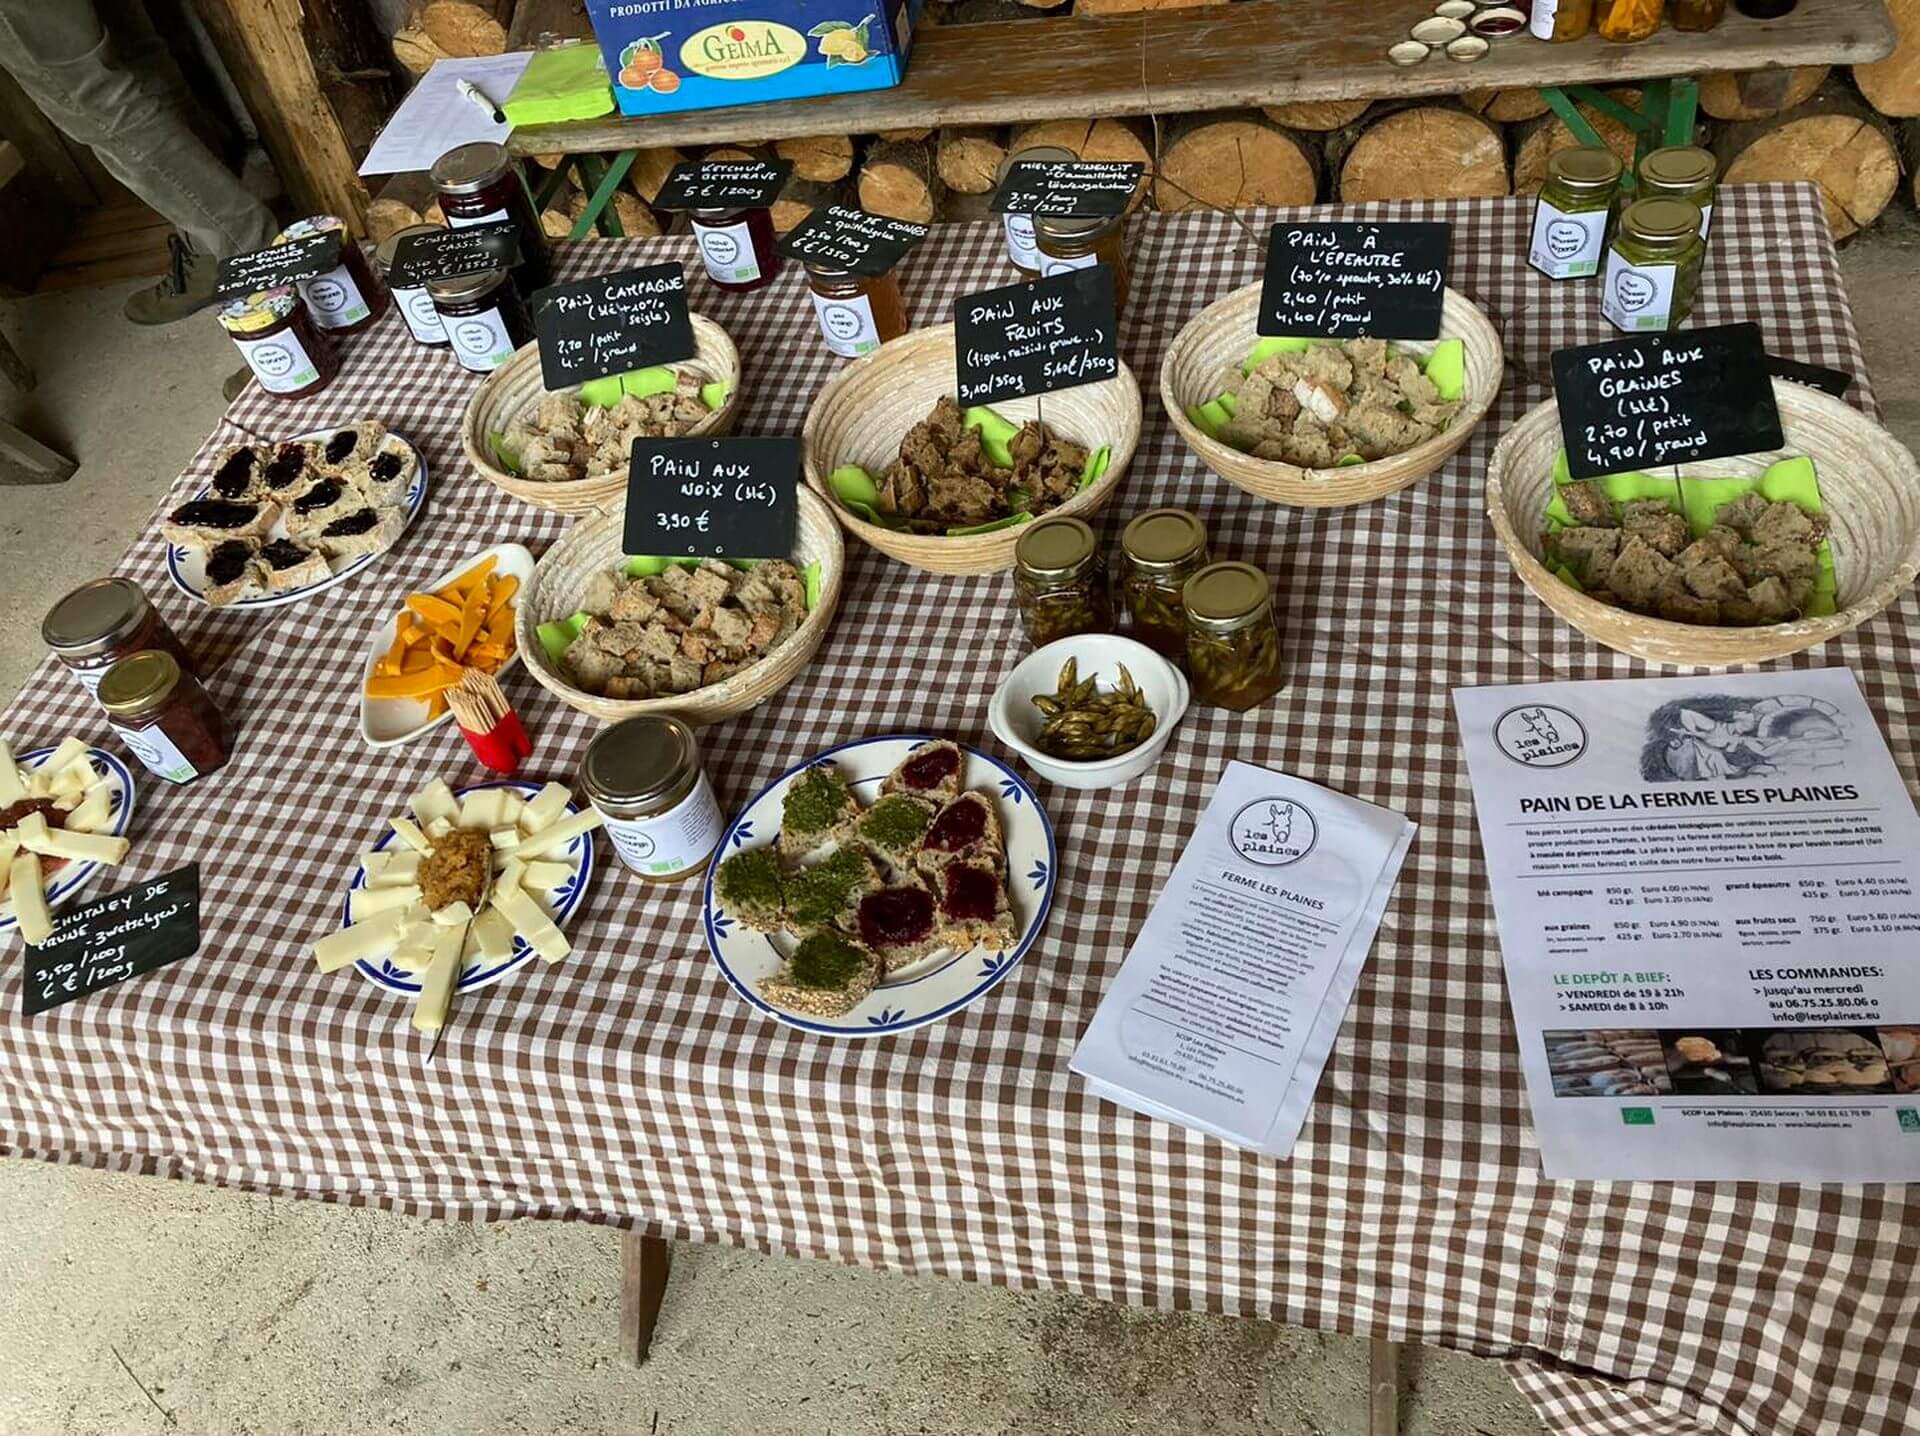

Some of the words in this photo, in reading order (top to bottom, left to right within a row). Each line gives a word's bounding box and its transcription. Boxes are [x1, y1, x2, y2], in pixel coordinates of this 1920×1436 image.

[610, 0, 670, 18] PRODOTTI
[674, 0, 691, 9] DA
[703, 28, 784, 62] GEIMA
[702, 163, 766, 172] KETCHUP
[1021, 163, 1047, 171] MIEL
[437, 238, 482, 252] CASSIS
[1287, 230, 1336, 248] PAIN
[1311, 245, 1404, 267] L'ÉPEAUTRE
[556, 294, 592, 313] PAIN
[605, 276, 684, 300] CAMPAGNE
[1282, 291, 1316, 307] 2,40
[970, 300, 1015, 325] PAIN
[1031, 296, 1064, 315] AUX
[1331, 311, 1371, 329] grand
[1004, 317, 1065, 342] FRUITS
[1587, 349, 1645, 375] PAIN
[1662, 347, 1704, 366] AUX
[1599, 370, 1683, 398] GRAINES
[1617, 395, 1670, 417] (blé)
[1585, 426, 1629, 446] 2,70
[1654, 430, 1708, 456] grand
[650, 454, 700, 478] PAIN
[712, 464, 750, 479] AUX
[681, 481, 724, 498] NOIX
[735, 483, 776, 507] (blé)
[656, 512, 690, 531] 3,90
[1515, 737, 1540, 750] les
[1523, 742, 1580, 762] plaines
[1520, 794, 1570, 814] PAIN
[1576, 794, 1608, 811] DE
[1611, 793, 1638, 809] LA
[1643, 789, 1719, 808] FERME
[1723, 788, 1761, 805] LES
[1764, 784, 1859, 804] PLAINES
[1244, 829, 1268, 841] les
[1242, 842, 1300, 857] plaines
[1222, 871, 1259, 891] FERME
[1260, 881, 1278, 896] LES
[1279, 886, 1326, 911] PLAINES
[1552, 889, 1593, 897] campagne
[50, 895, 132, 932] CHUTNEY
[144, 881, 170, 902] DE
[1561, 923, 1590, 932] graines
[38, 924, 89, 951] PRUNE
[36, 962, 74, 982] 3,50
[1554, 975, 1569, 985] LE
[1572, 971, 1619, 984] DEPÔT
[1620, 973, 1633, 983] A
[1635, 972, 1671, 983] BIEF:
[1749, 970, 1773, 980] LES
[1777, 966, 1884, 980] COMMANDES:
[1564, 990, 1620, 999] VENDREDI
[1623, 989, 1636, 998] de
[1639, 989, 1652, 998] 19
[1664, 988, 1685, 997] 21h
[1763, 985, 1811, 997] jusqu'au
[1814, 983, 1864, 994] mercredi
[1568, 1002, 1611, 1012] SAMEDI
[1613, 1002, 1627, 1011] de
[1648, 1001, 1669, 1010] 10h
[1785, 997, 1868, 1008] 06.75.25.80.06
[1772, 1011, 1880, 1023] info@lesplaines.eu
